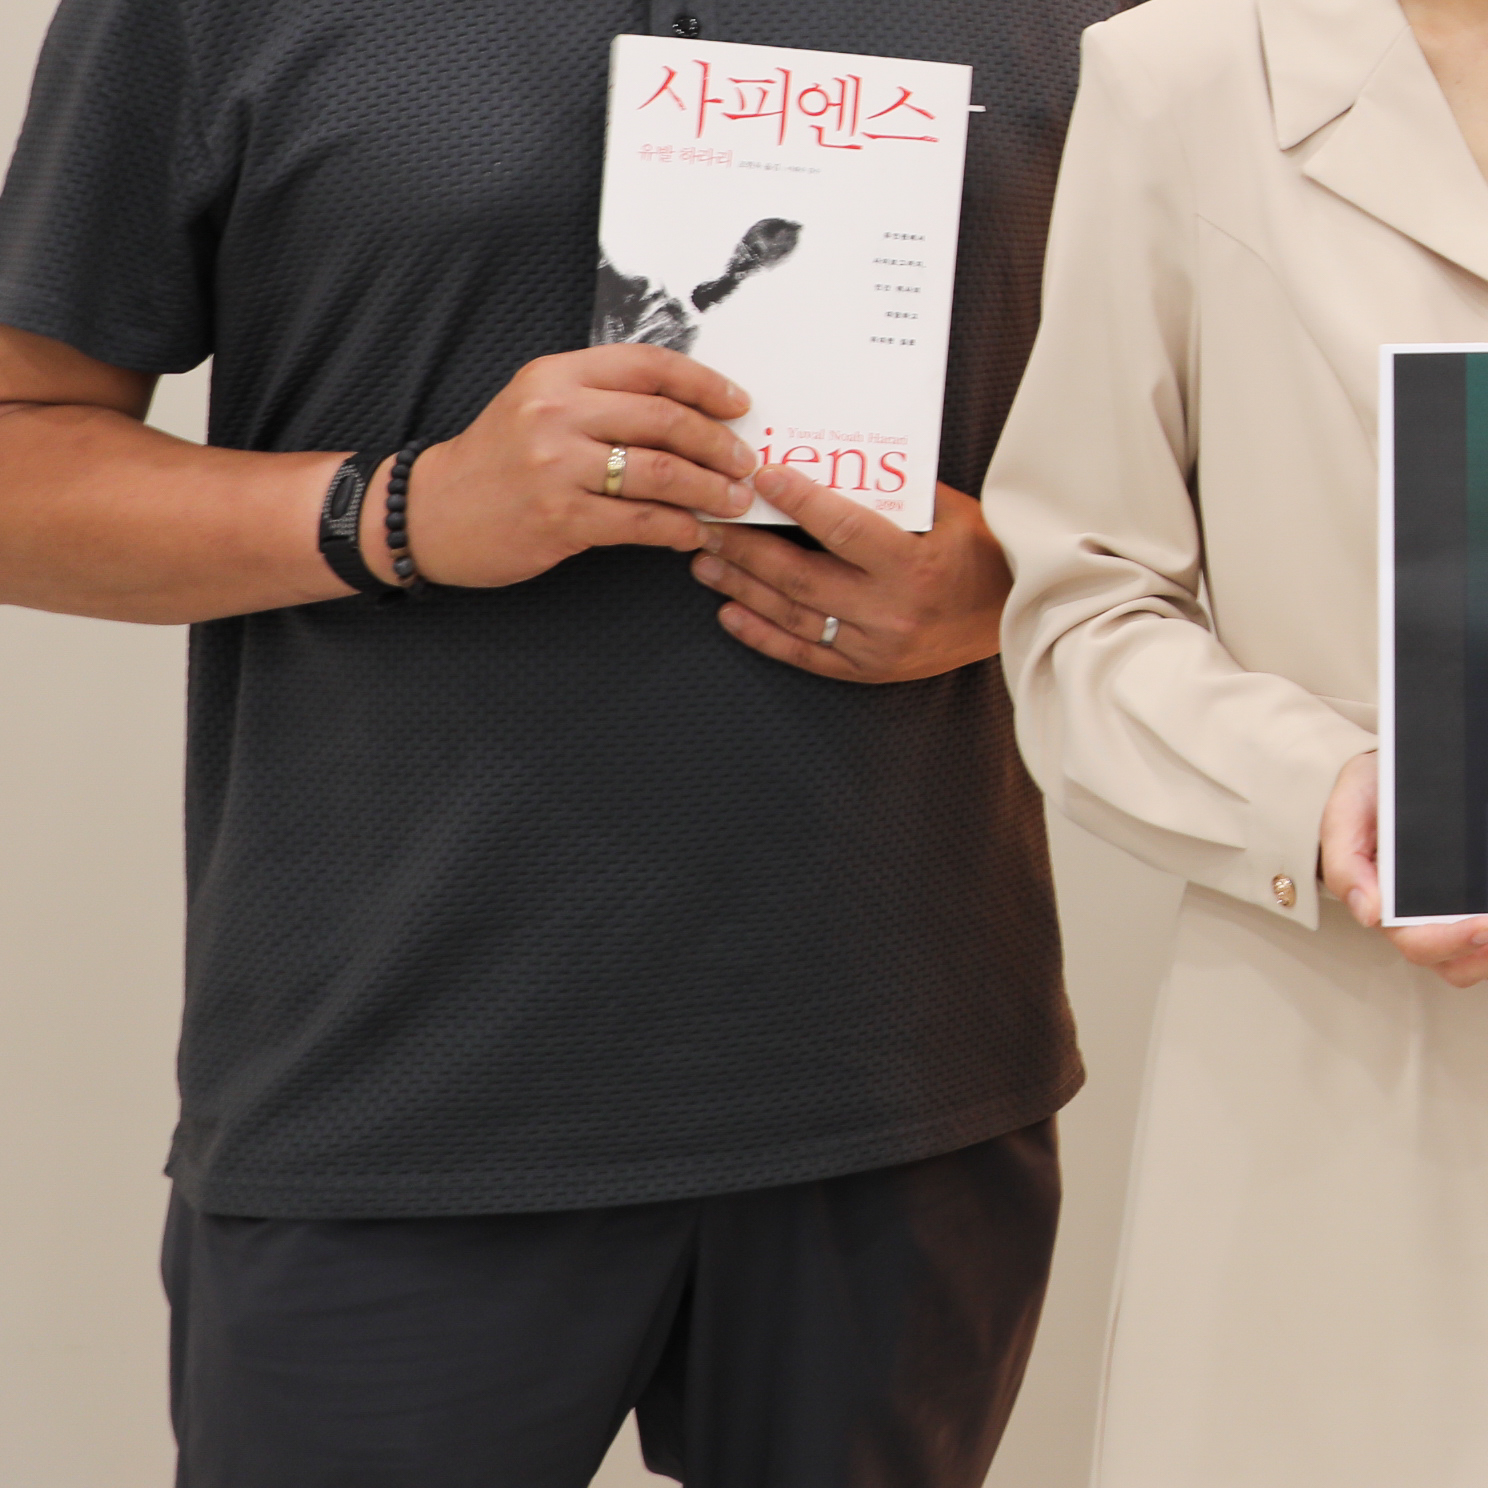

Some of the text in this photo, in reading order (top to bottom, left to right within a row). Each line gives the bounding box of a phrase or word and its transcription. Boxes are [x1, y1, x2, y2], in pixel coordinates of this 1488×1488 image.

[637, 58, 939, 150] 사피엔스
[638, 143, 677, 163] 유발
[678, 146, 733, 168] 하라리
